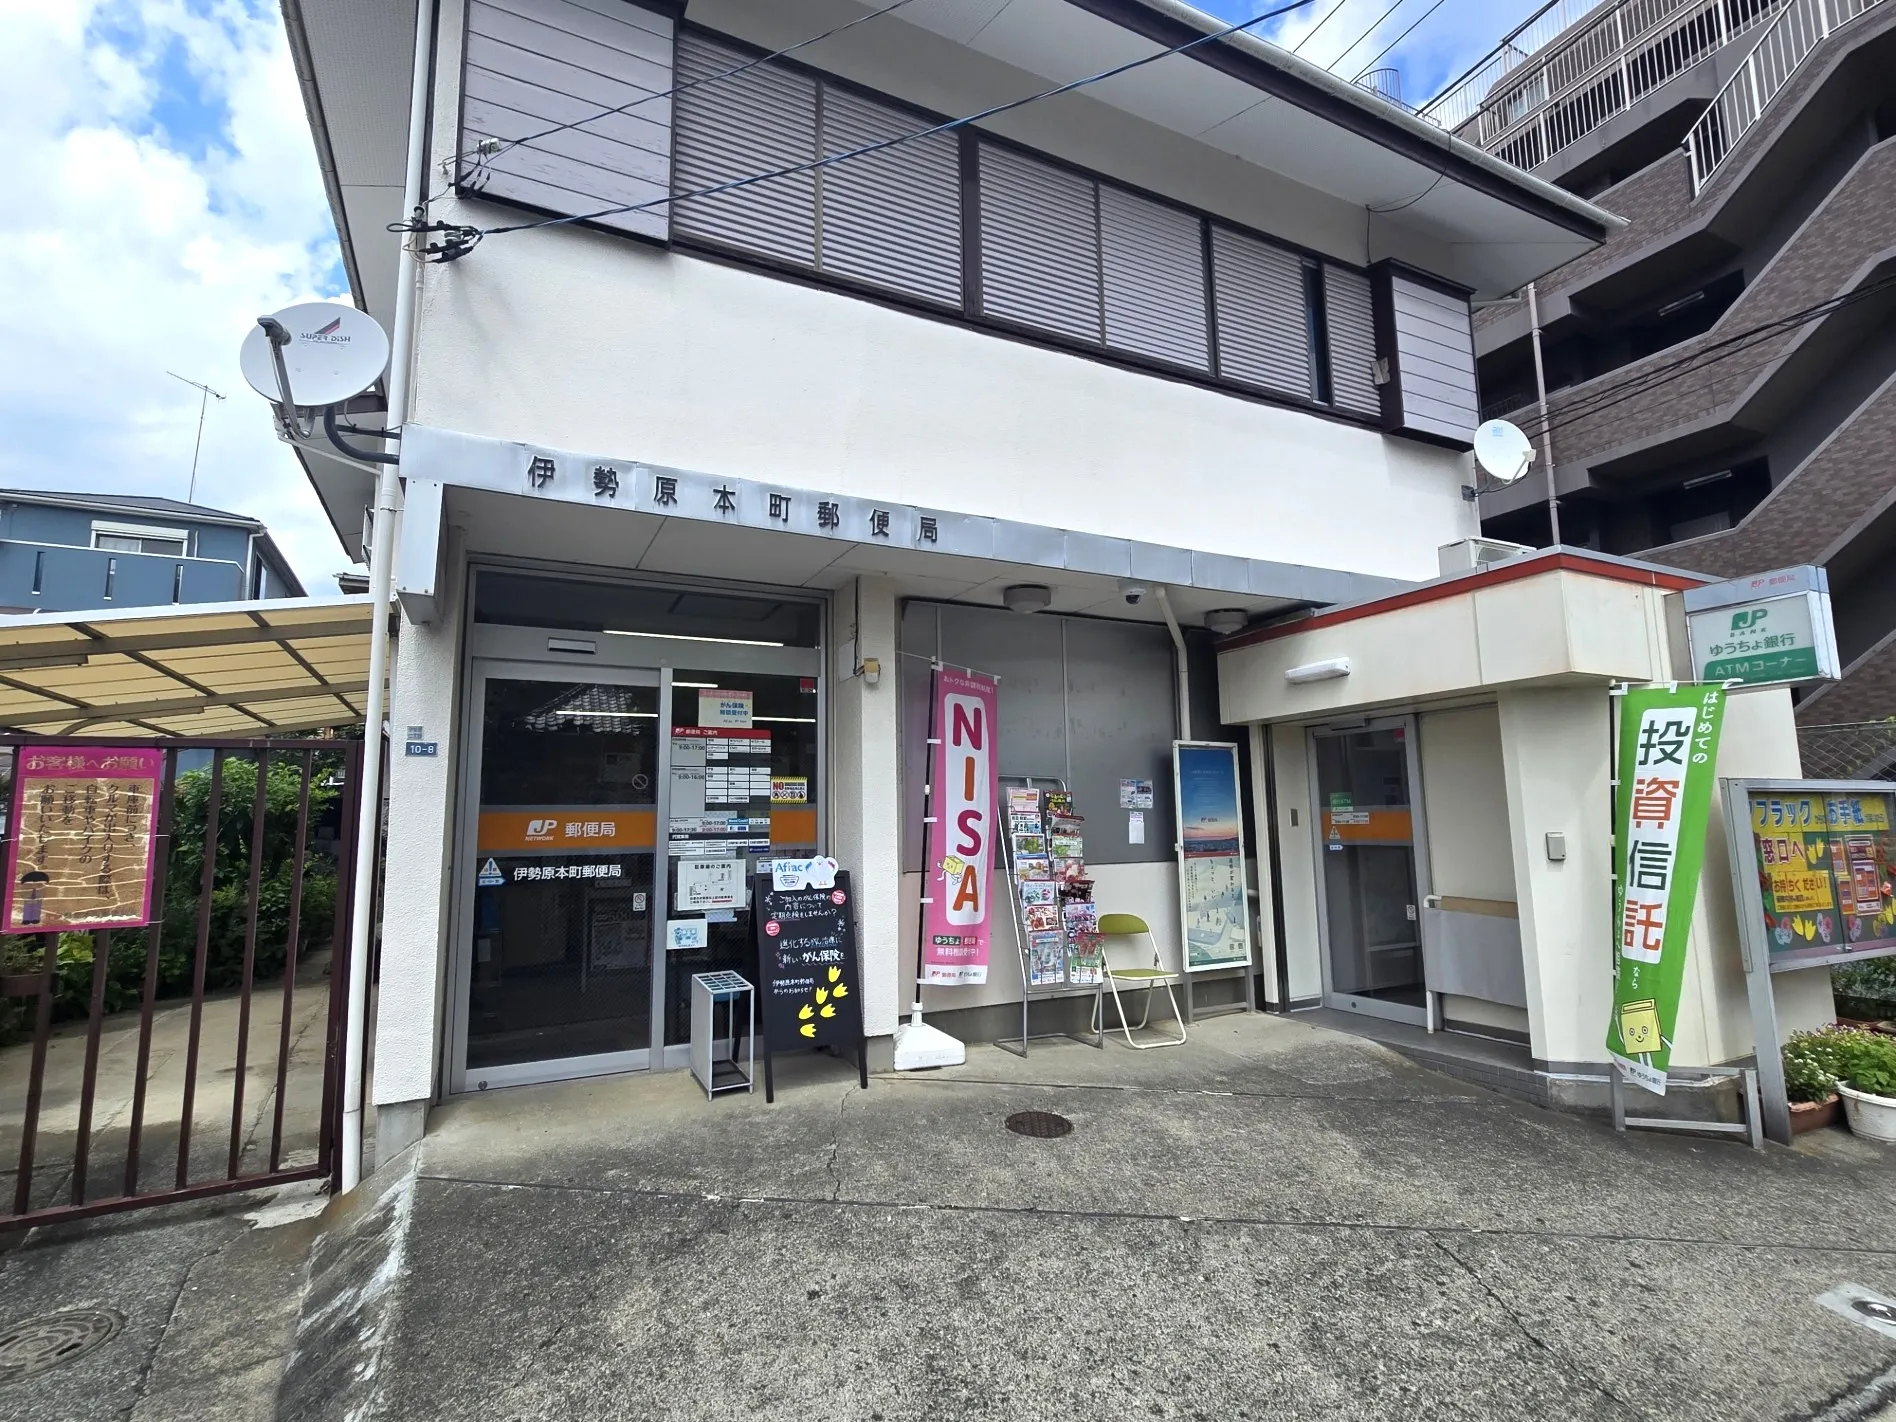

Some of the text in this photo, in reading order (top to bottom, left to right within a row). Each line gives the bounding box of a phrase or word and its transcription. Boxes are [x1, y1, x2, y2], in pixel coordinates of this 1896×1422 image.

[300, 332, 328, 342] SUPER
[527, 454, 939, 544] 伊勢原本町郵便局
[1731, 608, 1768, 631] JP
[1730, 627, 1767, 638] BANK
[1709, 632, 1796, 657] ゆうちょ銀行
[1714, 656, 1807, 677] ATMコーナー
[1692, 691, 1718, 764] はじめての
[410, 745, 434, 754] 10-8
[26, 755, 155, 771] お客様へお願い
[773, 782, 784, 790] NO
[952, 703, 983, 913] NISA
[1750, 800, 1811, 827] フラック
[36, 784, 56, 866] お願いいたします
[79, 784, 98, 864] 自転車やバイクの
[526, 819, 616, 838] JP 郵便局
[1623, 719, 1692, 954] 投資信託
[1761, 837, 1806, 865] 窓口へ
[513, 864, 622, 882] 伊勢原本町郵便局
[935, 936, 960, 945] ゆうちょ
[1631, 966, 1641, 990] なら
